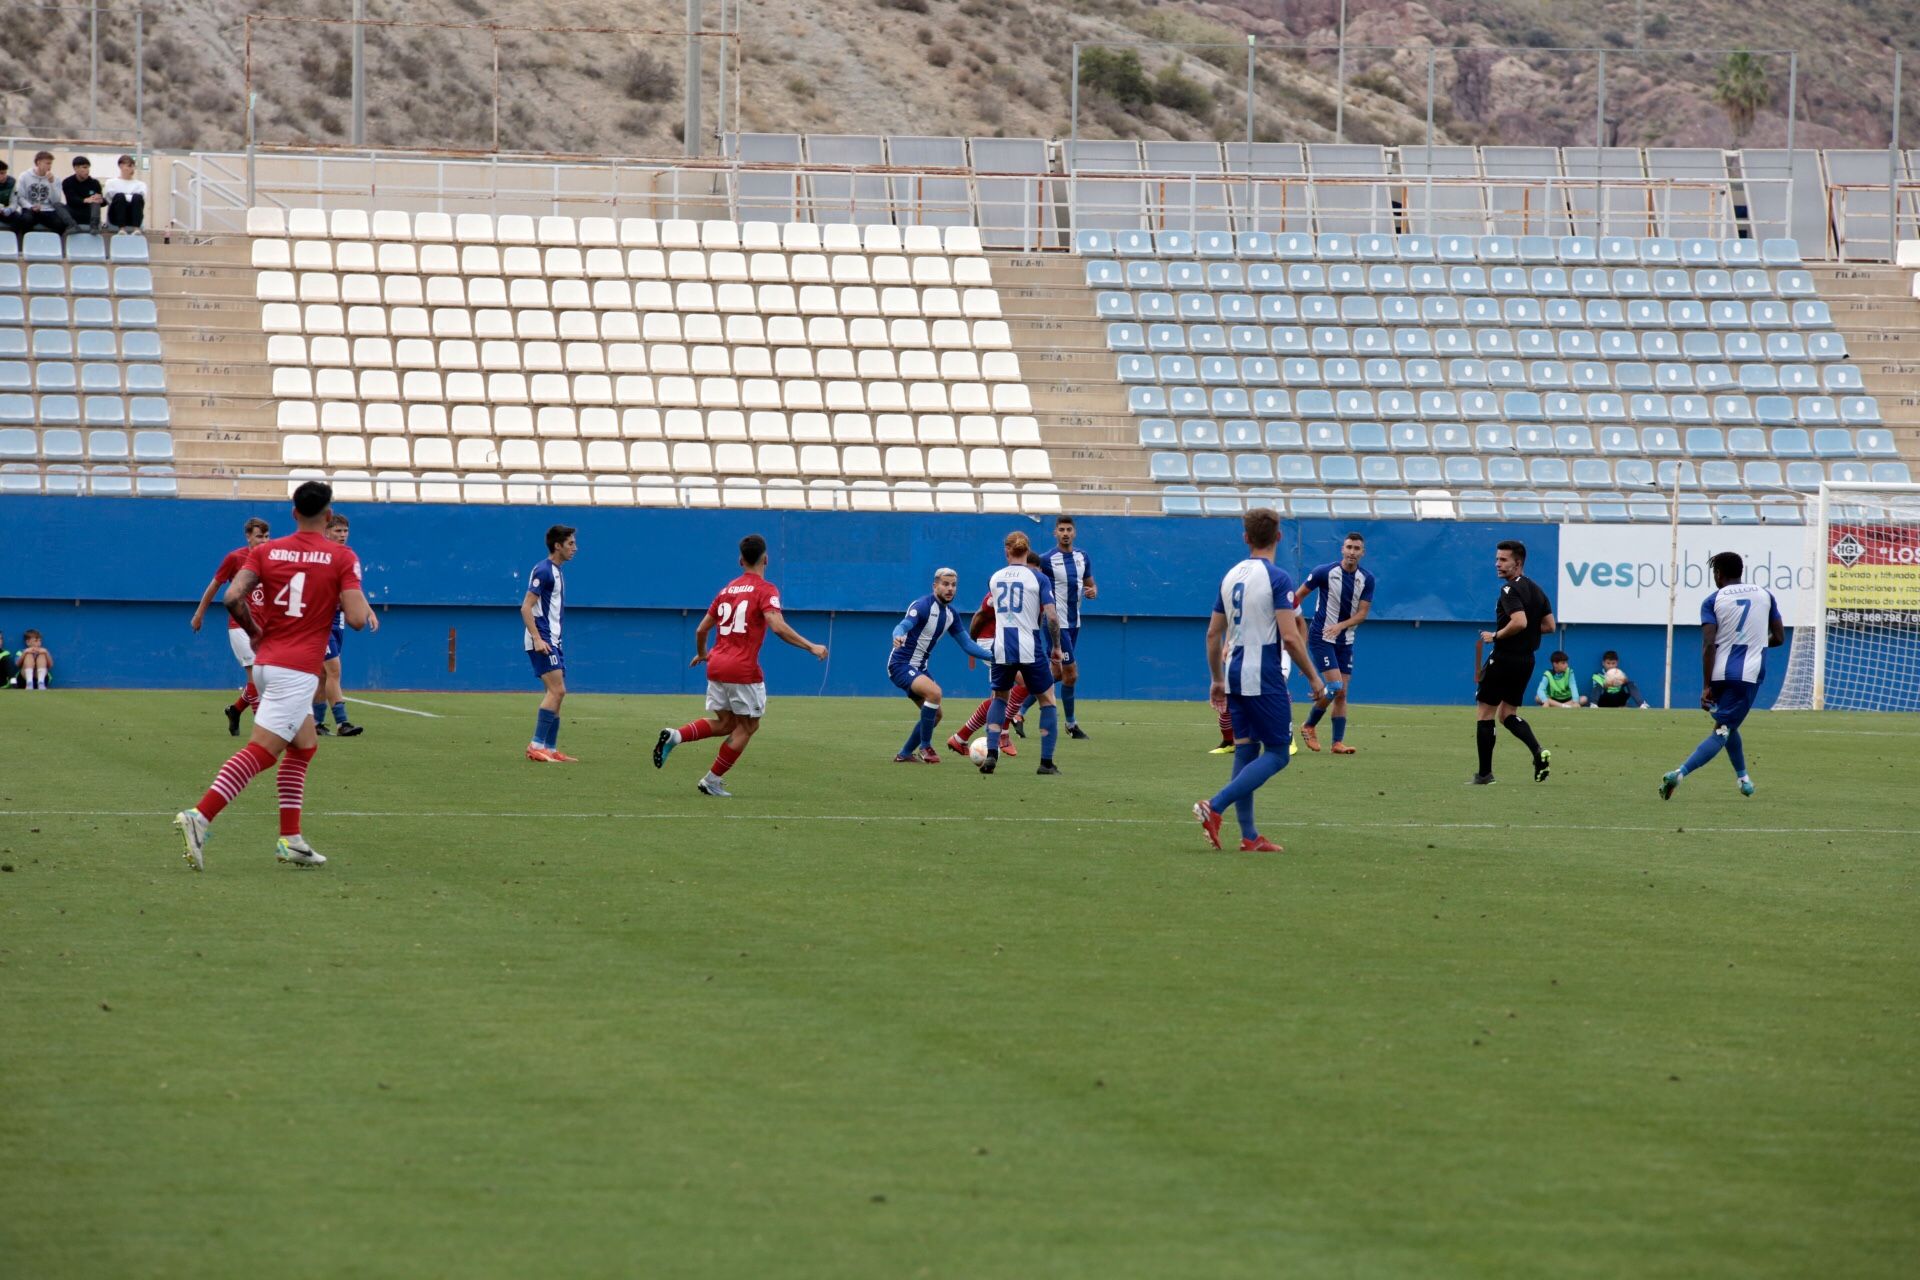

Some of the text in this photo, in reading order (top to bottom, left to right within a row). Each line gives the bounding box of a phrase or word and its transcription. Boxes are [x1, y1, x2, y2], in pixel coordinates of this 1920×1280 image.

[268, 549, 300, 562] SERGI
[1837, 545, 1860, 554] HGL
[1565, 550, 1816, 598] vespublidad
[274, 572, 306, 617] 4
[996, 581, 1024, 613] 20
[1231, 582, 1245, 625] 9
[717, 599, 750, 636] 24
[1735, 598, 1752, 632] 7
[1841, 613, 1860, 622] 968
[1863, 613, 1881, 622] 468
[549, 654, 558, 666] 10
[1323, 656, 1331, 667] 5
